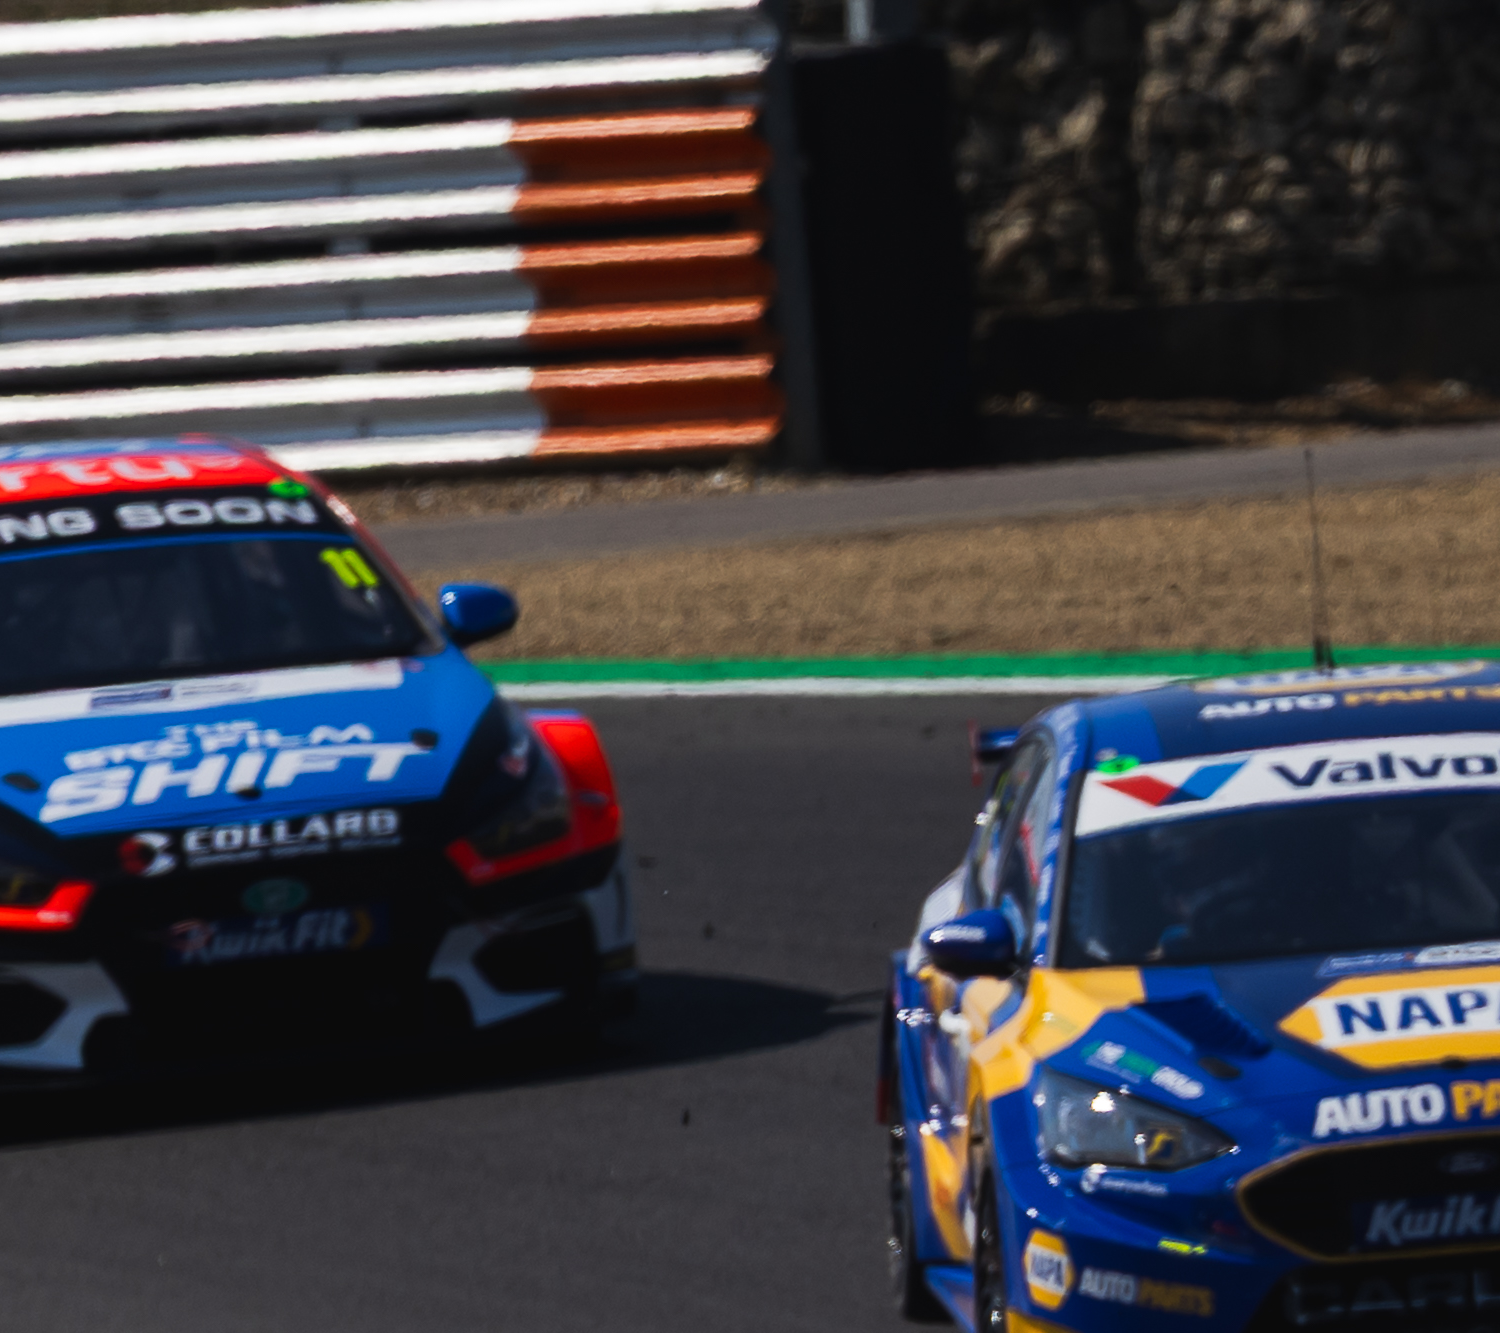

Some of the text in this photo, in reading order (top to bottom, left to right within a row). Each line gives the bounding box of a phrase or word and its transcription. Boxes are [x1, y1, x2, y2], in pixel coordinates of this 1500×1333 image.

[115, 497, 318, 529] SOON
[39, 743, 433, 823] SHIFT
[183, 808, 400, 855] COLLARD
[1312, 1083, 1446, 1139] AUTO
